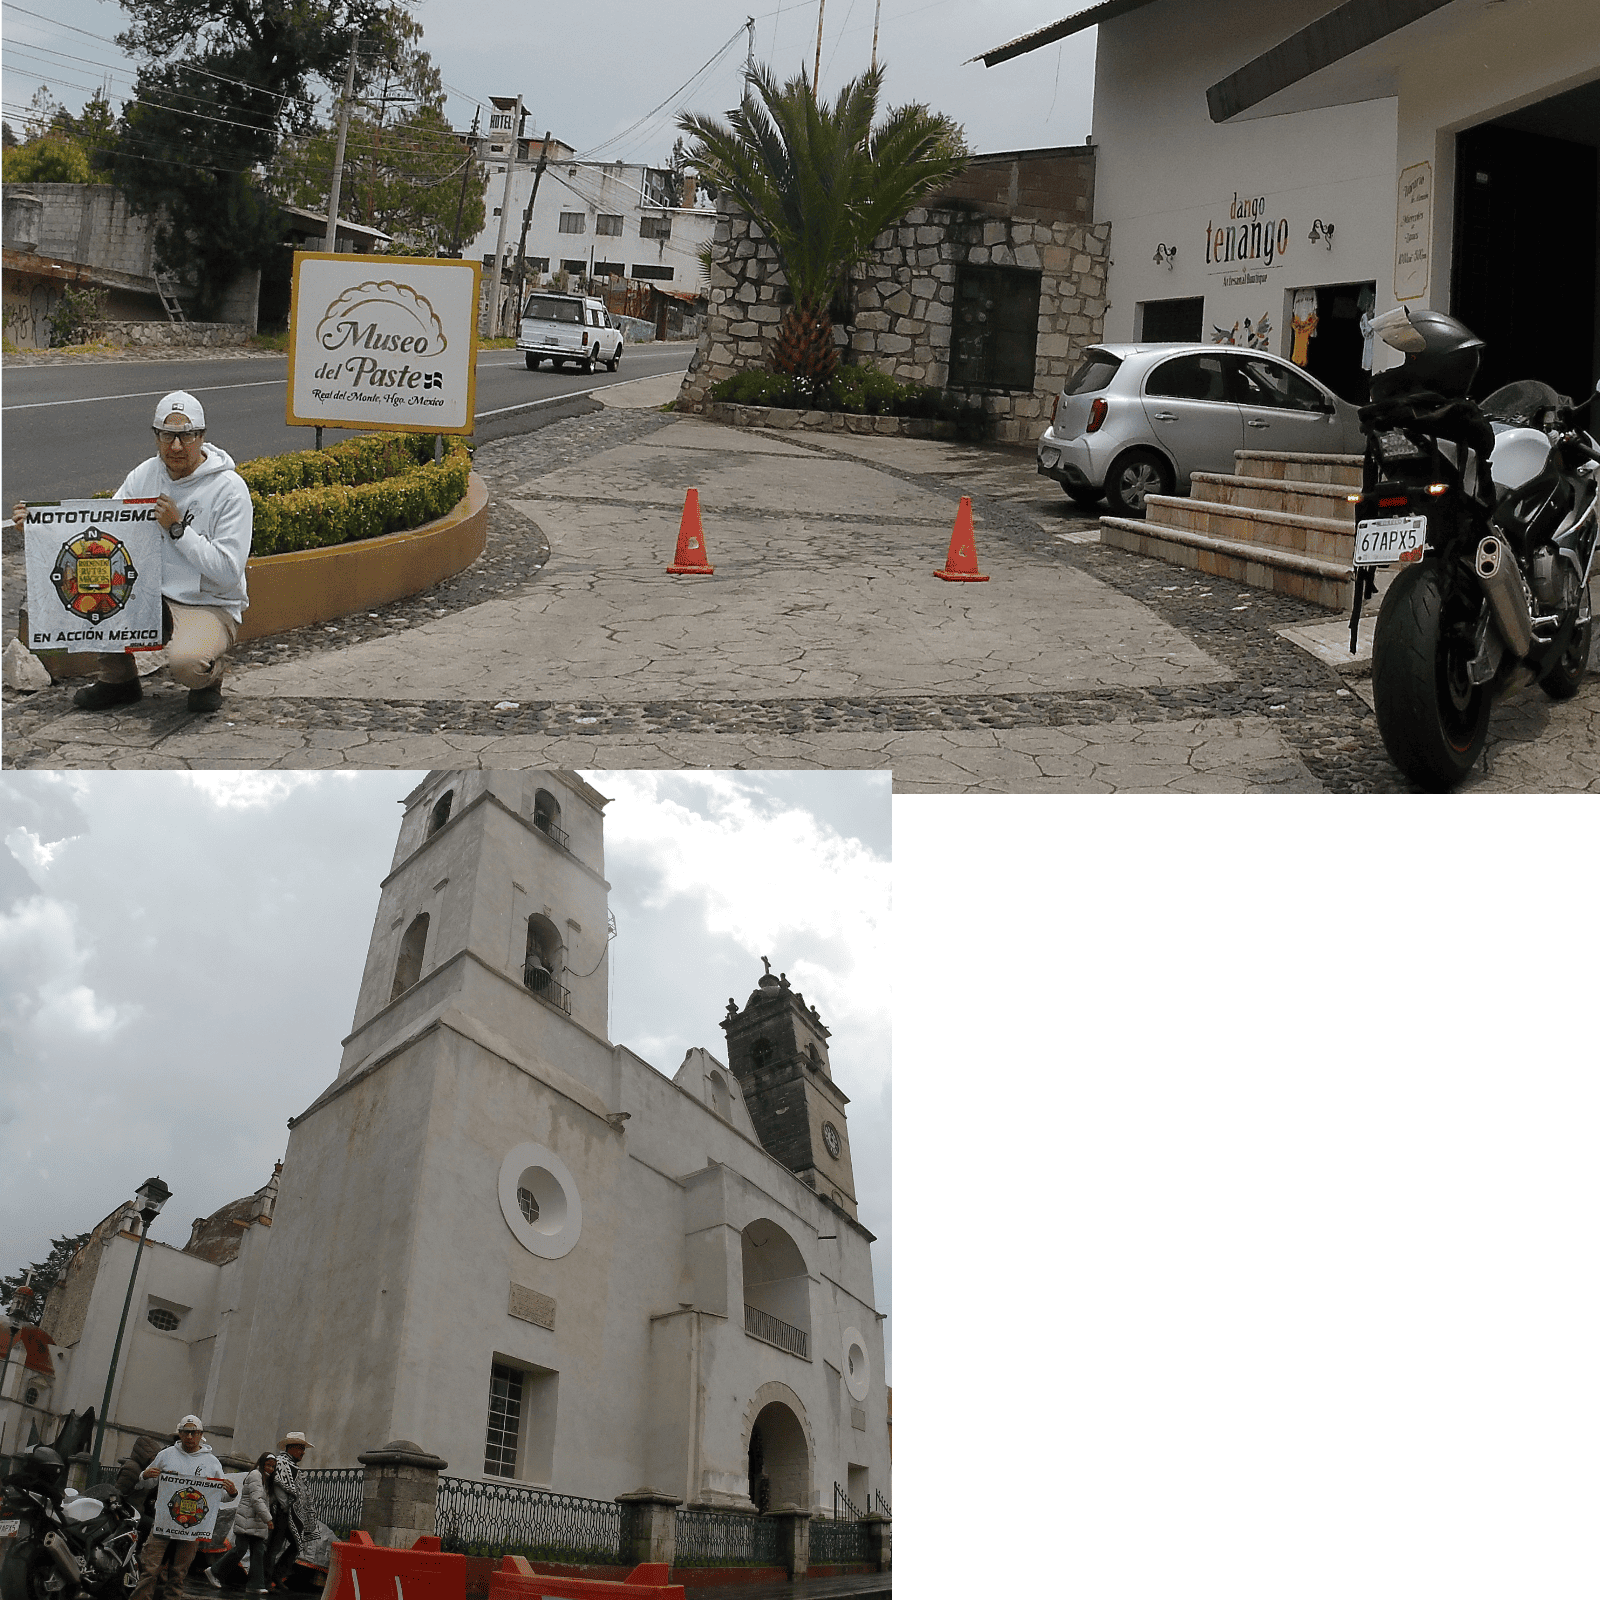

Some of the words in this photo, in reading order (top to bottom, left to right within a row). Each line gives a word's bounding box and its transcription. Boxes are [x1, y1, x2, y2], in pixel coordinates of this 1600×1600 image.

[490, 114, 512, 130] HOTEL
[1230, 192, 1265, 222] dango
[1206, 218, 1289, 266] tenango
[322, 321, 429, 354] Museo
[314, 363, 343, 380] del
[345, 356, 422, 389] Paste
[312, 389, 333, 403] Real
[333, 390, 347, 400] del
[88, 530, 98, 538] N
[1361, 530, 1417, 552] 67APX5
[52, 573, 62, 581] O
[127, 571, 135, 579] E
[91, 613, 100, 621] S
[33, 633, 51, 643] EN
[56, 627, 103, 642] ACCIÓN
[108, 627, 158, 641] MÉXICO
[160, 1475, 223, 1489] MOTOTURISMO
